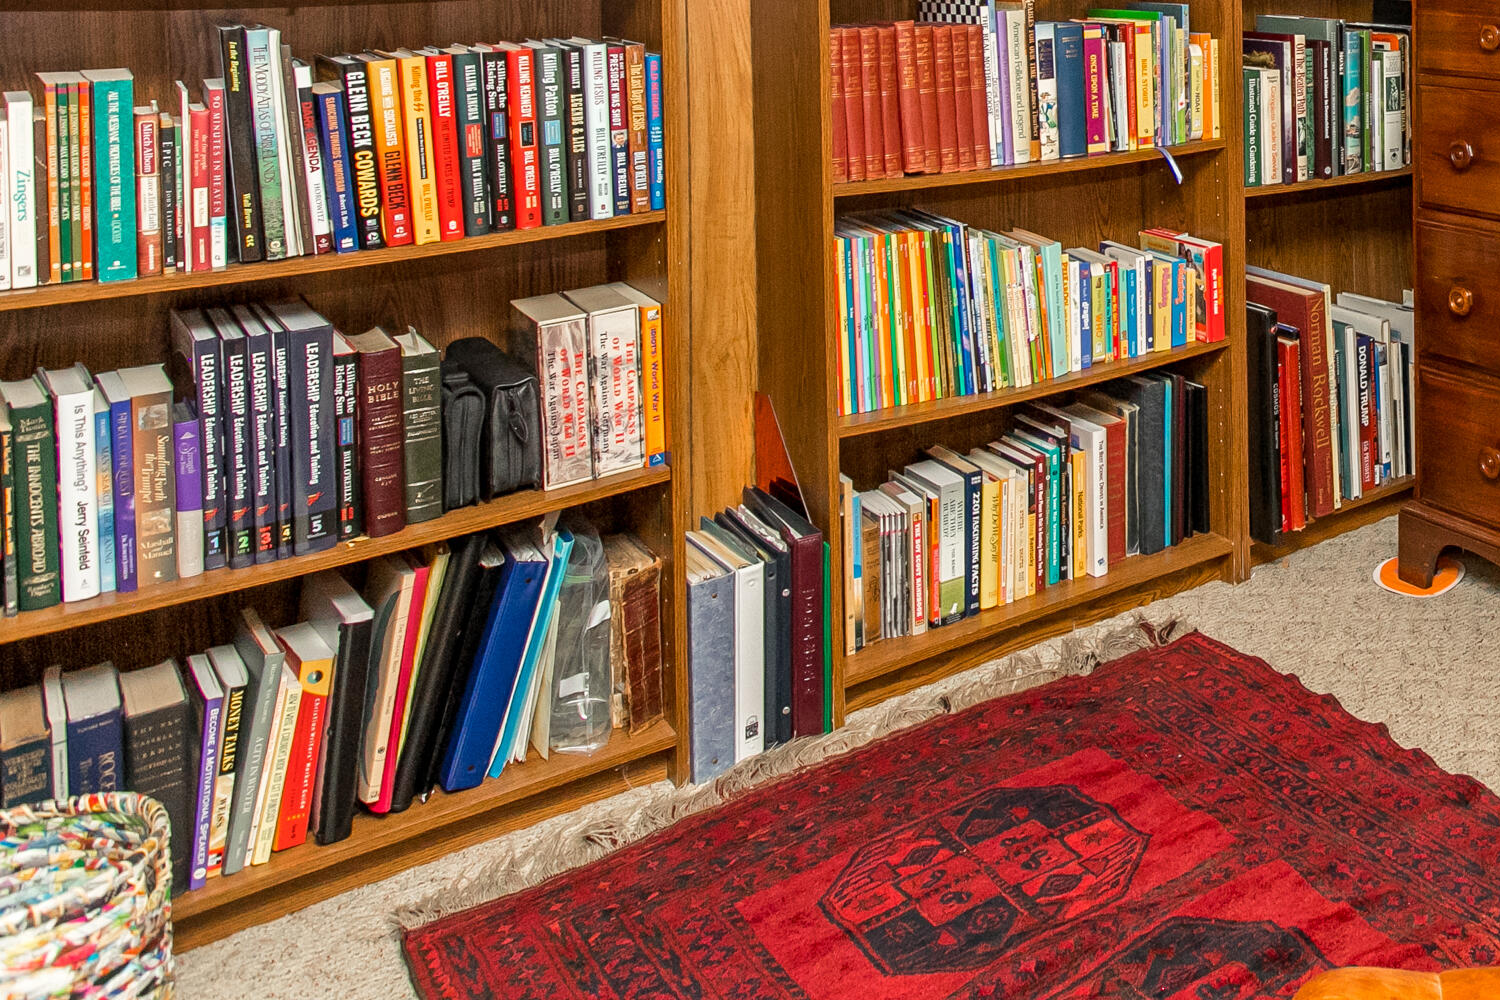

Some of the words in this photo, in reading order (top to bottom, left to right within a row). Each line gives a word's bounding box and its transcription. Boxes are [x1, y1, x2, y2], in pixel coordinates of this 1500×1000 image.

[435, 61, 447, 81] BILL
[464, 64, 477, 92] KILLING
[485, 61, 497, 90] Rising
[494, 60, 505, 92] Killing
[518, 55, 530, 84] KILLING
[542, 53, 557, 84] Killing
[593, 51, 603, 81] KILLING
[609, 54, 621, 91] PRESIDENT
[212, 96, 221, 108] 90
[345, 71, 367, 113] GLENN
[437, 82, 451, 117] O'REILLY
[465, 93, 479, 121] LINCOLN
[488, 91, 498, 110] Sun
[499, 93, 507, 109] the
[519, 85, 532, 118] KENNEDY
[544, 85, 560, 117] Patton
[594, 83, 604, 106] JESUS
[611, 93, 621, 107] WAS
[1030, 89, 1038, 109] James
[1248, 78, 1256, 113] Illustrated
[352, 115, 372, 148] BECK
[611, 109, 622, 127] SHOT
[1248, 114, 1256, 136] Guide
[142, 123, 153, 146] Mitch
[212, 112, 222, 157] MINUTES
[1249, 136, 1255, 144] to
[143, 147, 154, 173] Albom
[213, 160, 222, 171] IN
[384, 151, 402, 182] GLENN
[523, 150, 534, 165] BILL
[549, 148, 560, 163] BILL
[616, 152, 626, 167] BILL
[1248, 145, 1257, 183] Gardening
[213, 174, 224, 213] HEAVEN
[354, 150, 378, 217] COWARDS
[524, 165, 536, 191] O'REILLY
[549, 164, 562, 193] O'REILLY
[617, 169, 628, 197] O'REILLY
[13, 170, 32, 222] Zingers
[313, 183, 325, 223] HOROWITZ
[387, 184, 405, 210] BECK
[1082, 301, 1090, 330] dragon!
[1095, 314, 1103, 338] WHO
[599, 331, 608, 349] The
[1309, 298, 1325, 366] Norman
[574, 351, 584, 376] THE
[600, 352, 609, 370] War
[625, 340, 635, 364] THE
[1358, 345, 1368, 389] DONALD
[200, 353, 216, 415] LEADERSHIP
[229, 354, 246, 415] LEADERSHIP
[251, 351, 268, 412] LEADERSHIP
[305, 342, 321, 402] LEADERSHIP
[334, 365, 345, 395] Rising
[345, 363, 355, 398] Killing
[335, 395, 345, 415] Sun
[346, 399, 355, 414] the
[599, 374, 609, 408] Against
[626, 370, 638, 435] CAMPAIGNS
[74, 405, 86, 414] Is
[308, 403, 319, 439] Education
[575, 381, 587, 448] CAMPAIGNS
[1312, 373, 1330, 449] Rockwell
[1360, 391, 1369, 427] TRUMP
[74, 416, 86, 439] This
[204, 417, 216, 453] Education
[233, 417, 245, 453] Education
[255, 414, 267, 449] Education
[600, 411, 609, 454] Germany
[207, 454, 217, 469] and
[236, 454, 245, 469] and
[258, 451, 268, 465] and
[310, 440, 319, 454] and
[73, 442, 88, 492] Anything?
[257, 466, 270, 496] Training
[310, 454, 321, 485] Training
[205, 469, 218, 500] Training
[234, 469, 247, 500] Training
[75, 501, 88, 526] Jerry
[972, 492, 980, 515] 2201
[78, 529, 90, 571] Seinfeld
[971, 516, 980, 563] FASCINATING
[971, 564, 979, 596] FACTS
[206, 708, 220, 745] BECOME
[226, 690, 244, 732] MONEY
[221, 733, 238, 772] TALKS
[200, 756, 215, 822] MOTIVATIONAL
[216, 798, 227, 828] WEISS
[197, 823, 209, 865] SPEAKER
